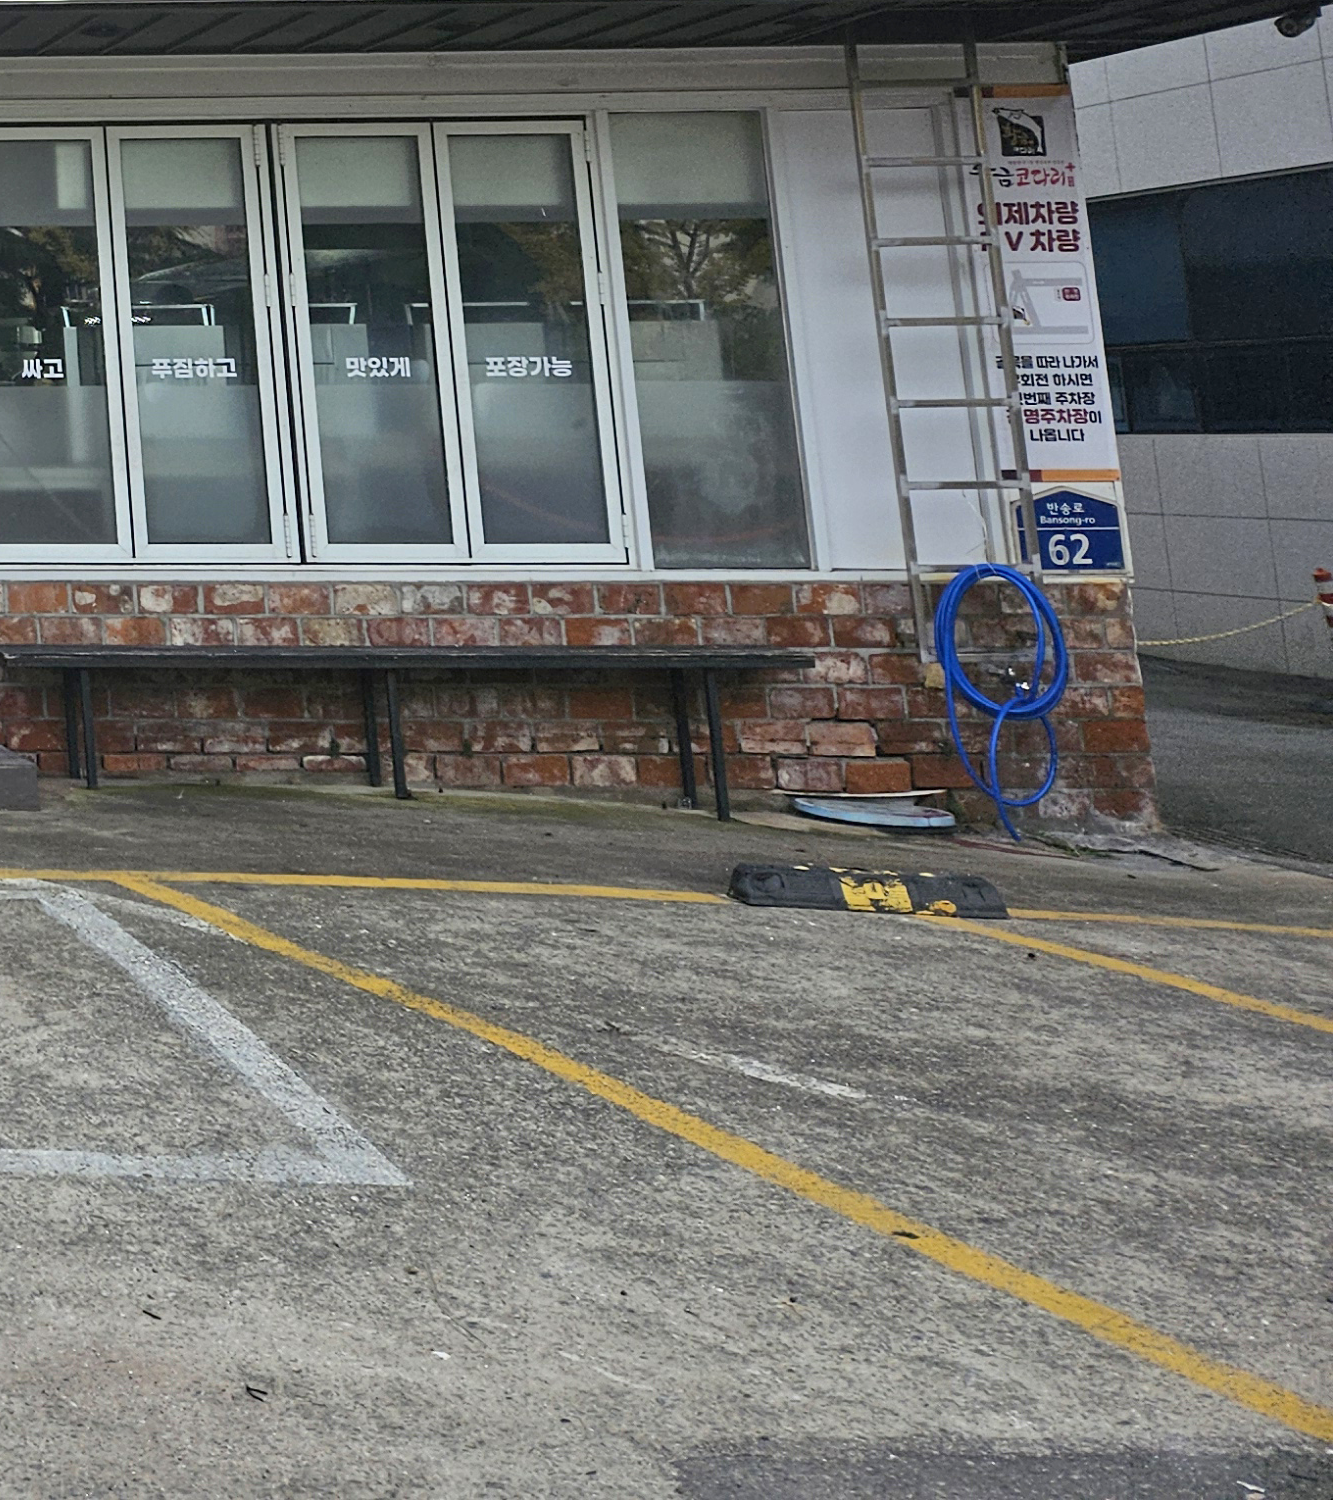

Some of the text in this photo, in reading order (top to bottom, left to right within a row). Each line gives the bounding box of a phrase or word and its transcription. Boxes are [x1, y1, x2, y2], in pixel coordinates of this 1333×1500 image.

[1029, 229, 1081, 252] 차량
[21, 355, 573, 381] 싸고 푸짐하고 맛있게 포장가능
[1036, 355, 1060, 369] 따라
[1063, 355, 1099, 369] 나가서
[1017, 373, 1093, 387] 회전 하시면
[1019, 392, 1095, 405] 번째 주차장
[1006, 408, 1102, 424] 명주차장이
[1029, 428, 1085, 441] 나옵니다
[1046, 502, 1085, 516] 반송로
[1039, 516, 1096, 525] Bansong-ro
[1048, 533, 1093, 566] 62
